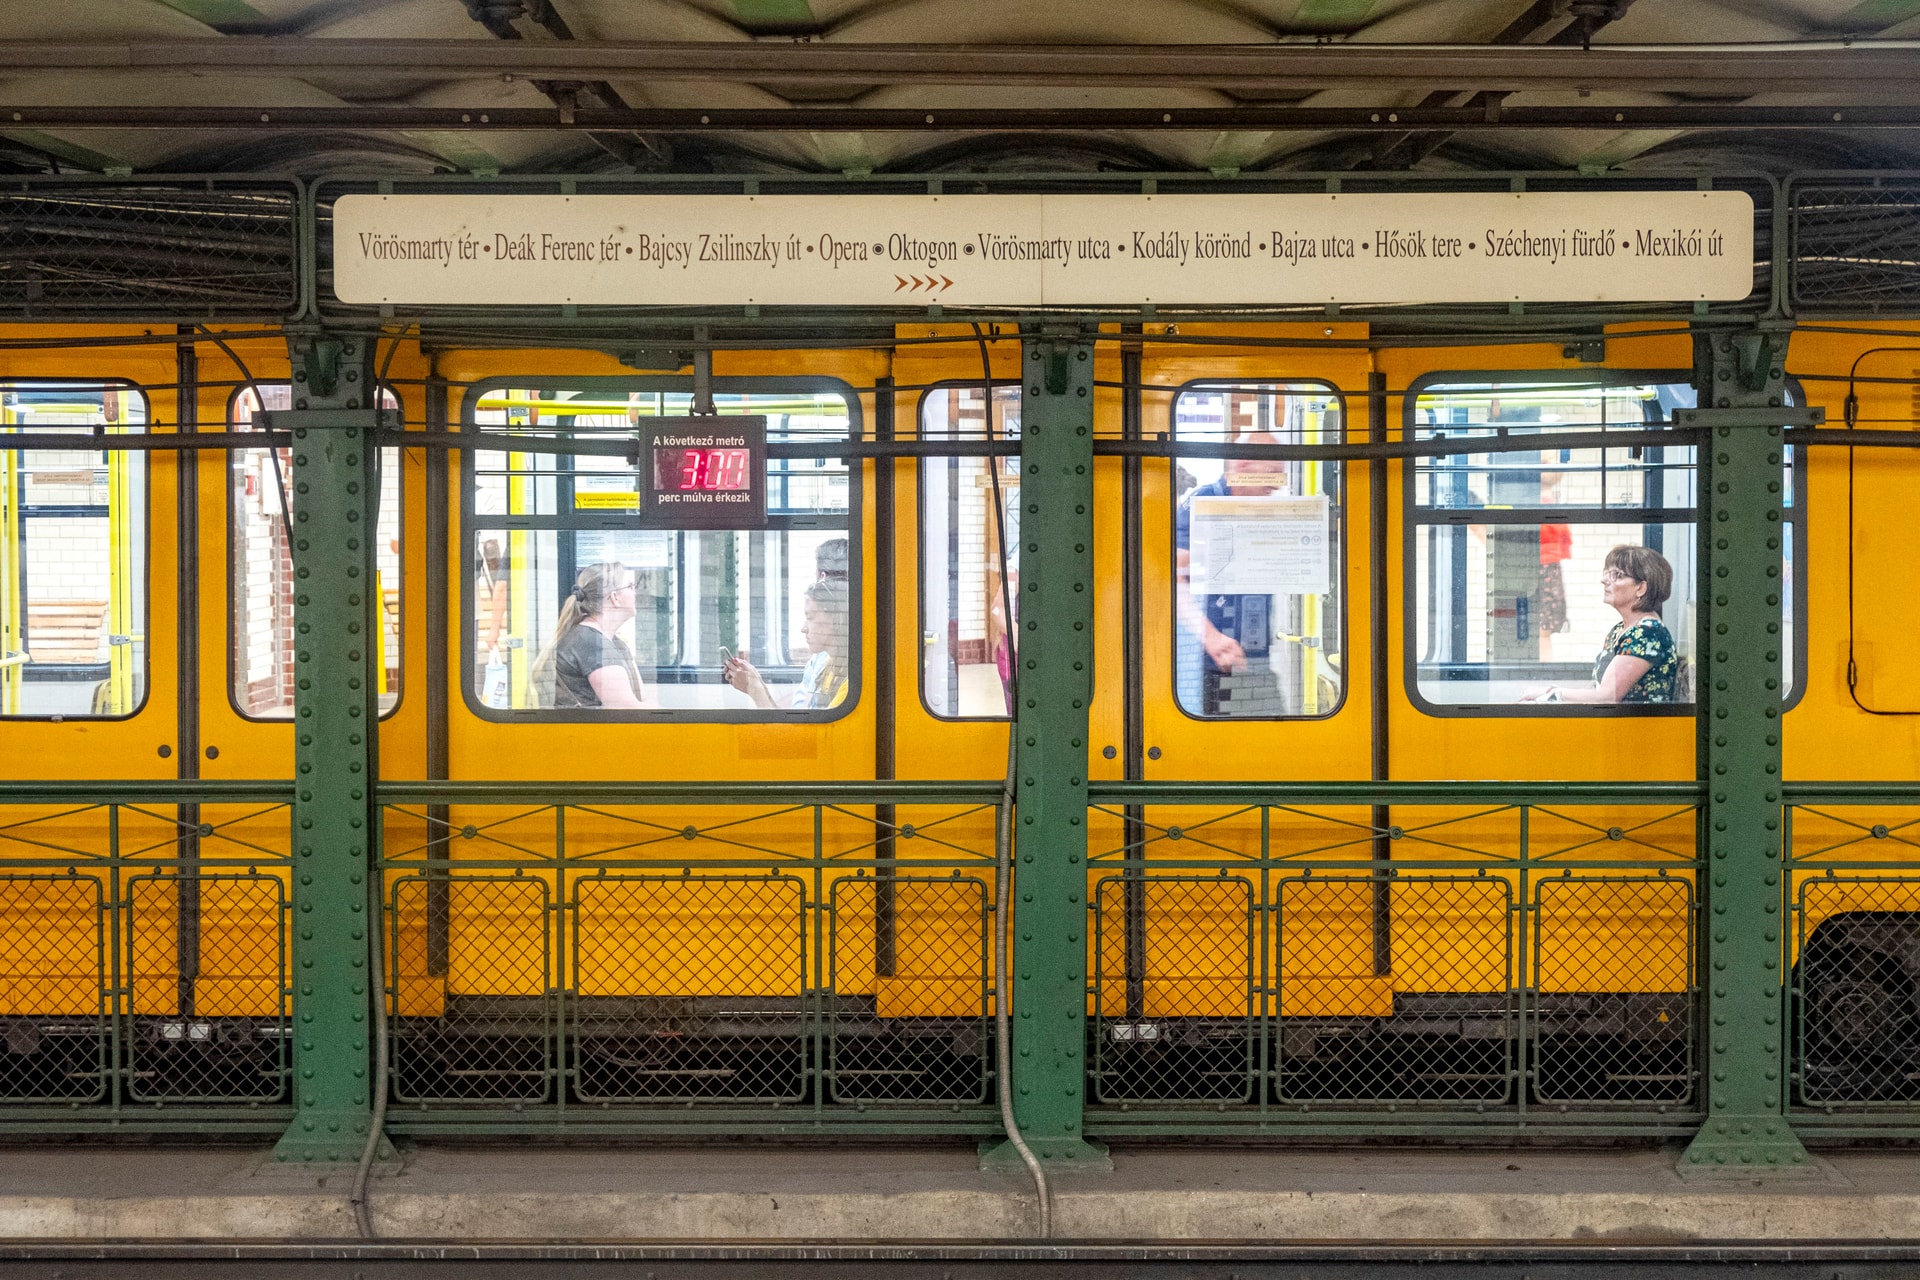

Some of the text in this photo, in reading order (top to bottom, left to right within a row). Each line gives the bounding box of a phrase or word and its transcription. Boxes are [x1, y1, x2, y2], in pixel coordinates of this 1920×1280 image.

[359, 228, 1724, 269] Vörösmarty tér Deák Ferenc tér Bajcsy Zsilinszky út Opera Oktogon Vörösmarty utca Kodály körönd Bajza utca Hősök tere Széchenyi fürdő Mexikói út
[653, 435, 745, 446] A következő metró
[680, 451, 746, 490] 3:00
[658, 492, 751, 504] perc múlva érkezik
